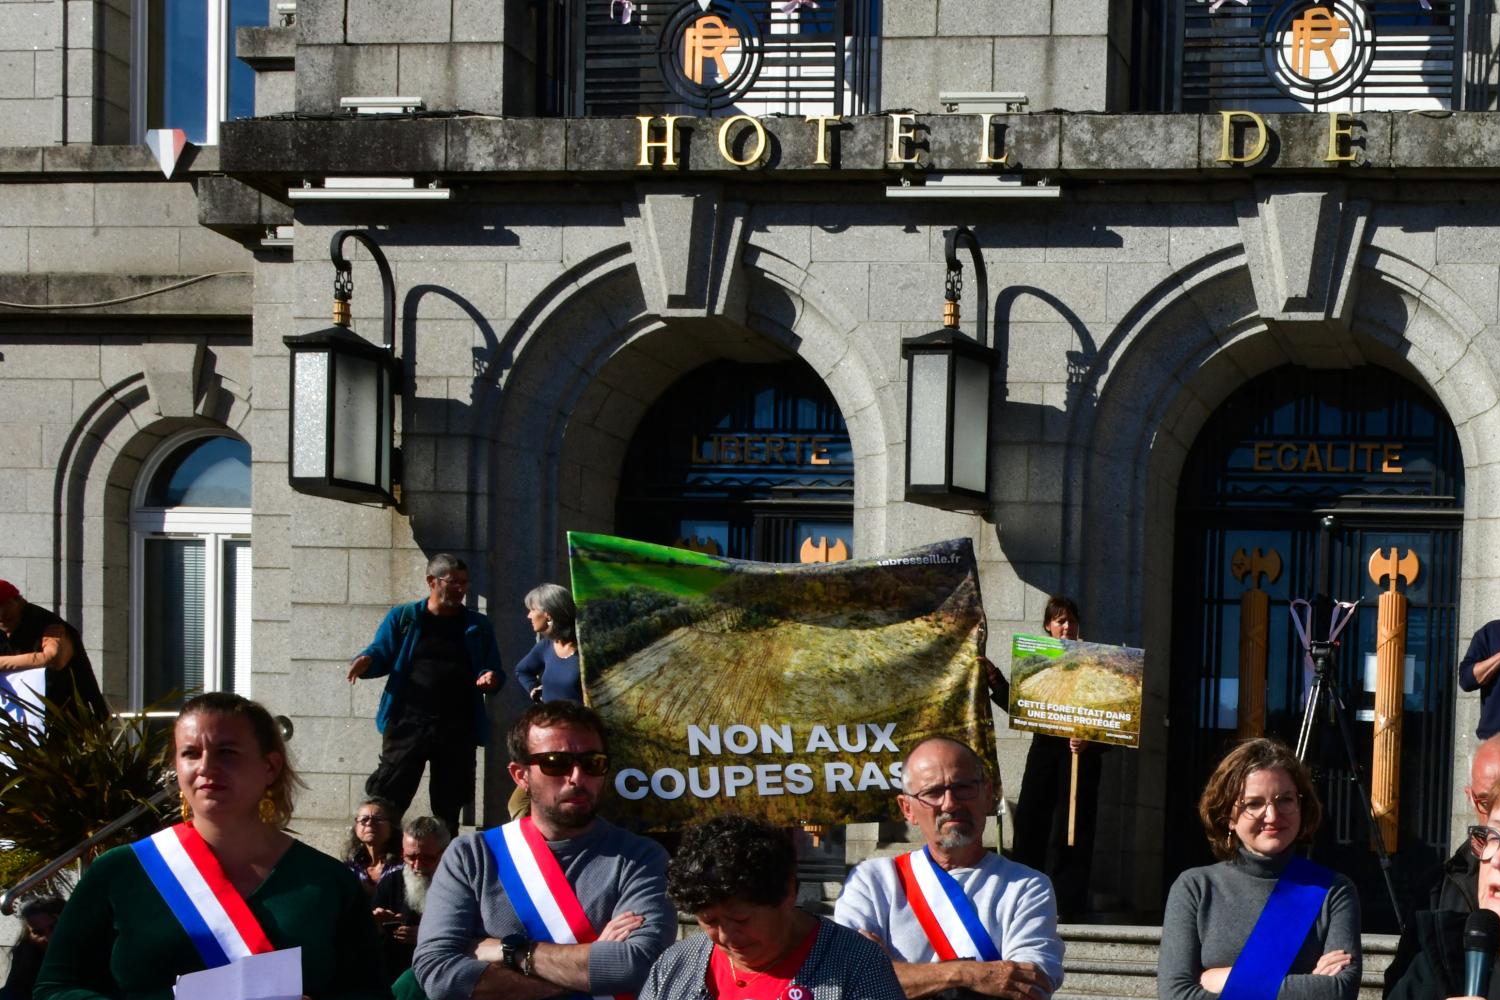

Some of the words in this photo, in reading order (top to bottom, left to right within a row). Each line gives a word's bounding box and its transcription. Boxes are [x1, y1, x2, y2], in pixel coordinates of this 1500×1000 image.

[636, 113, 1009, 166] HOTEL
[1216, 111, 1357, 162] DE
[1017, 699, 1046, 710] CETTE
[1105, 711, 1131, 721] DANS
[1027, 710, 1047, 719] UNE
[1048, 711, 1073, 723] ZONE
[687, 724, 794, 756] NON
[806, 723, 899, 753] AUX
[615, 763, 813, 800] COUPES
